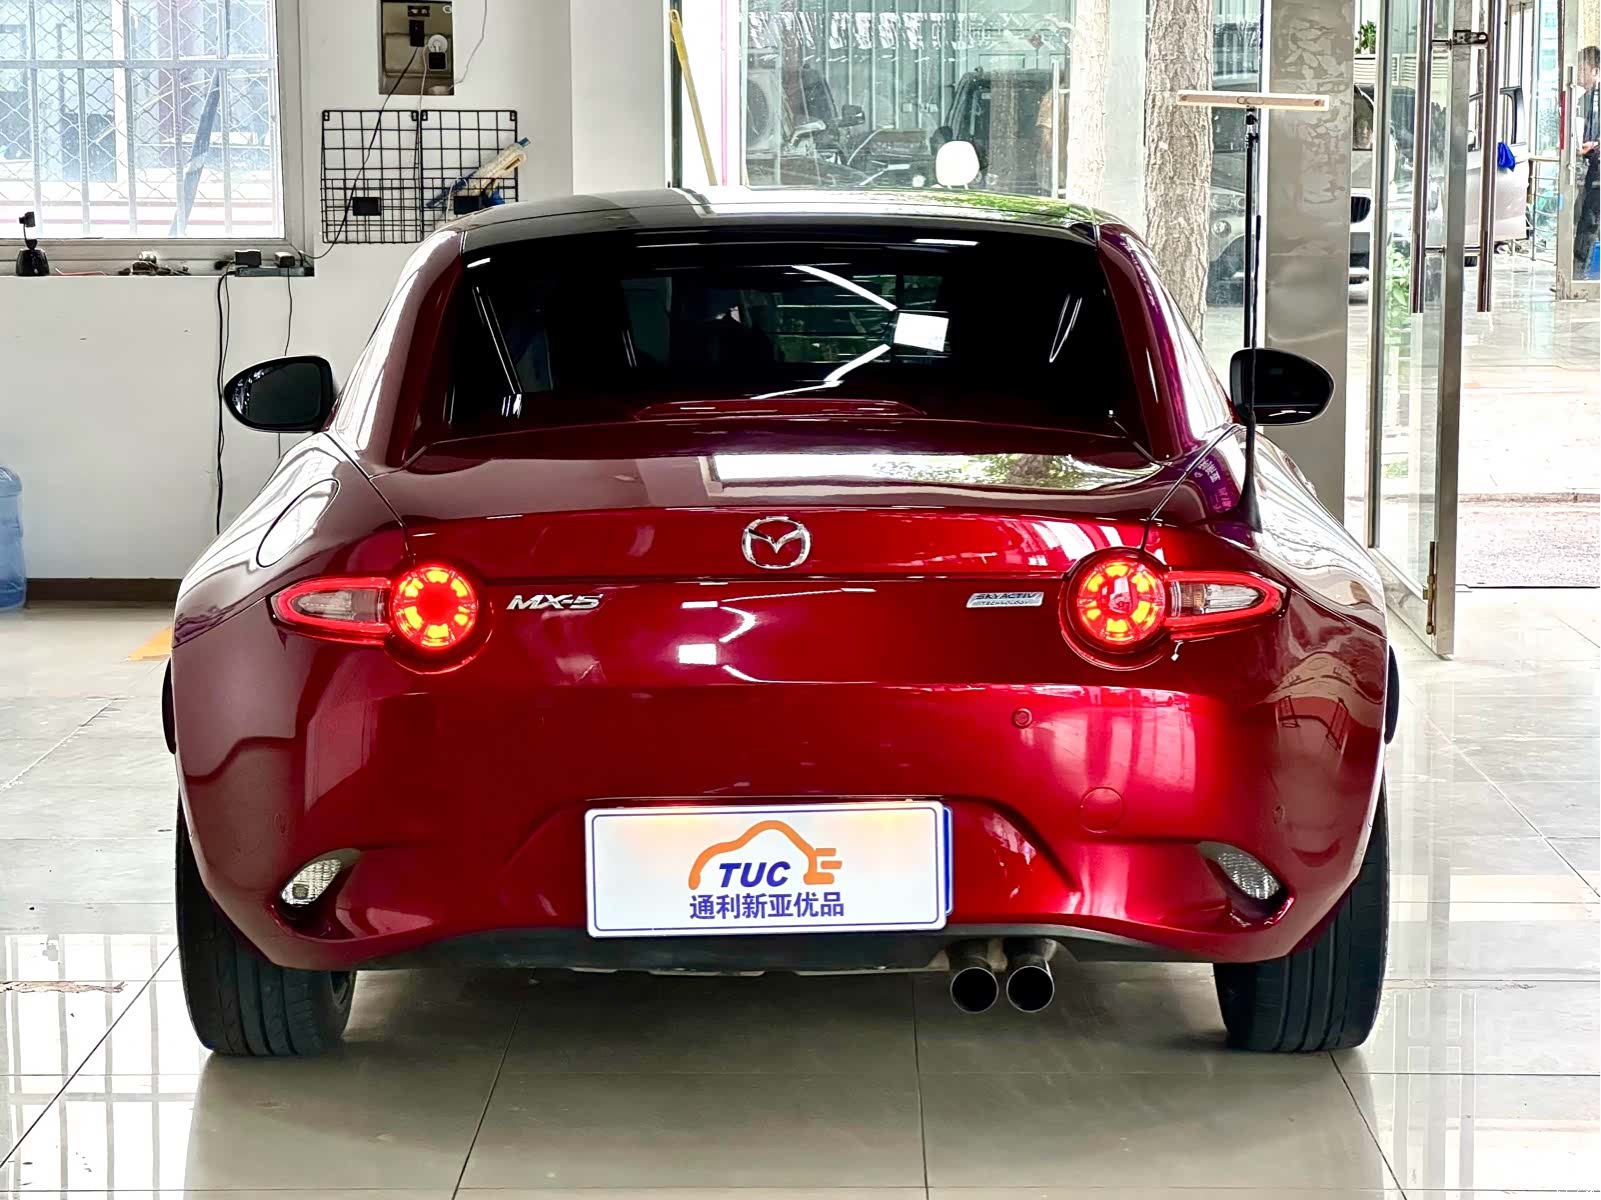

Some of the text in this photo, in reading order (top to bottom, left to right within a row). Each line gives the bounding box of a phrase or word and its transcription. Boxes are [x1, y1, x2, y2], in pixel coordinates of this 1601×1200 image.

[506, 594, 604, 610] MX-5
[718, 861, 791, 888] TUC
[689, 891, 845, 920] 通利新亚优品
